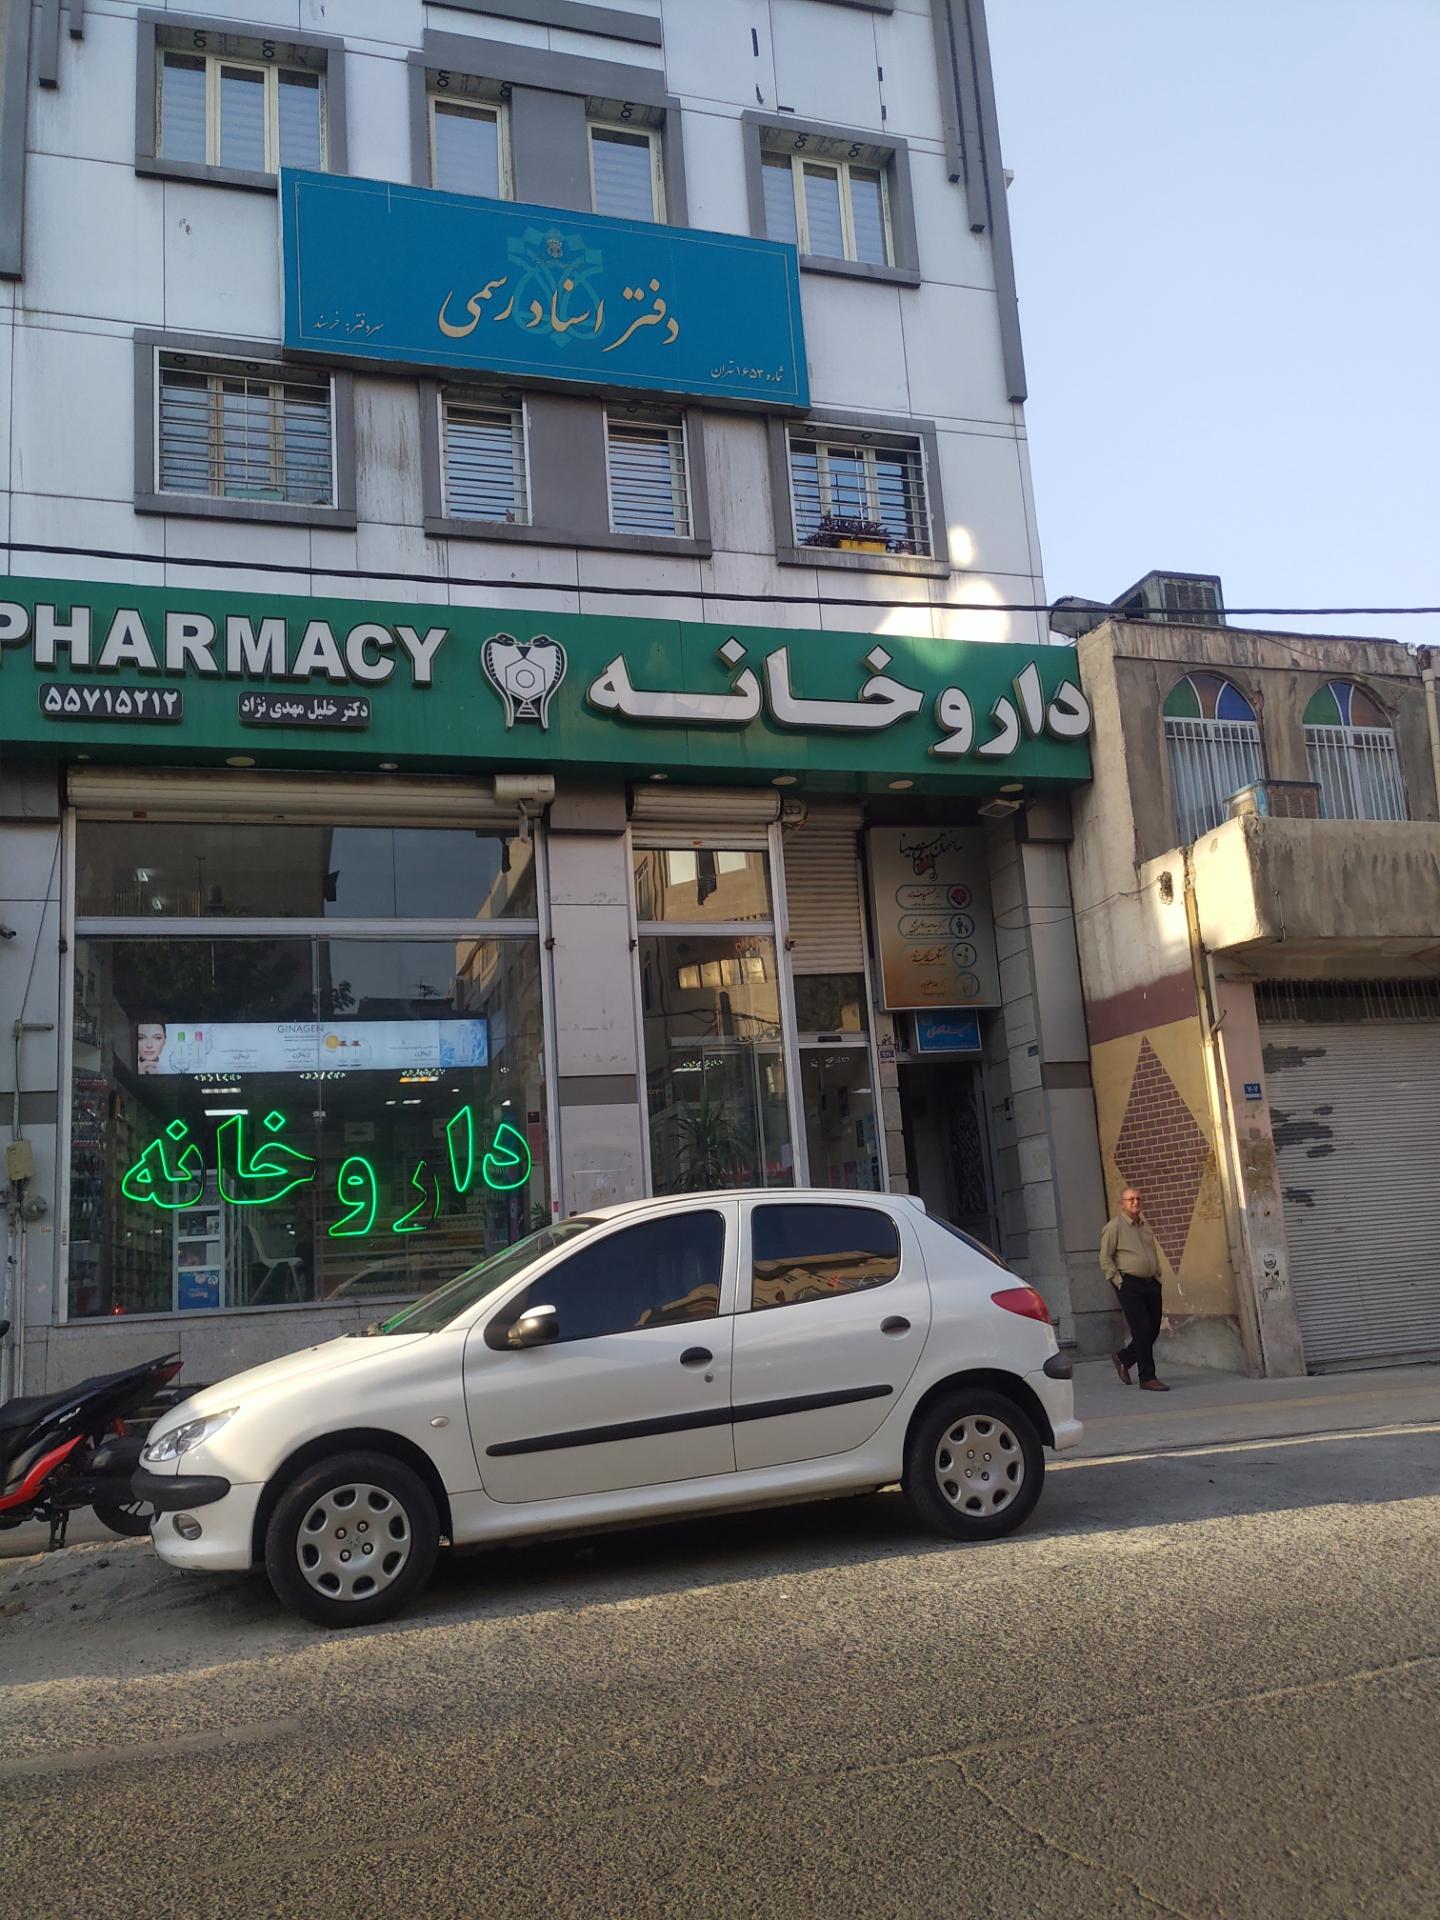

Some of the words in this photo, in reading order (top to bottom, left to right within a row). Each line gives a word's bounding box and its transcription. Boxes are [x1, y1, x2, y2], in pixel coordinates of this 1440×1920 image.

[438, 275, 515, 338] رسمی
[526, 278, 605, 335] اسناد
[602, 278, 680, 352] دفتر
[710, 360, 735, 378] تهران
[766, 365, 784, 382] شماره
[44, 686, 178, 716] ۵۵۷۱۵۲۱۲
[241, 696, 267, 718] نژاد
[586, 635, 1093, 759] داروخانه
[269, 700, 305, 719] مهدی
[307, 699, 338, 720] خلیل
[340, 700, 369, 722] دکتر
[277, 1023, 325, 1034] GINAGEN
[120, 1105, 533, 1239] داروخانه
